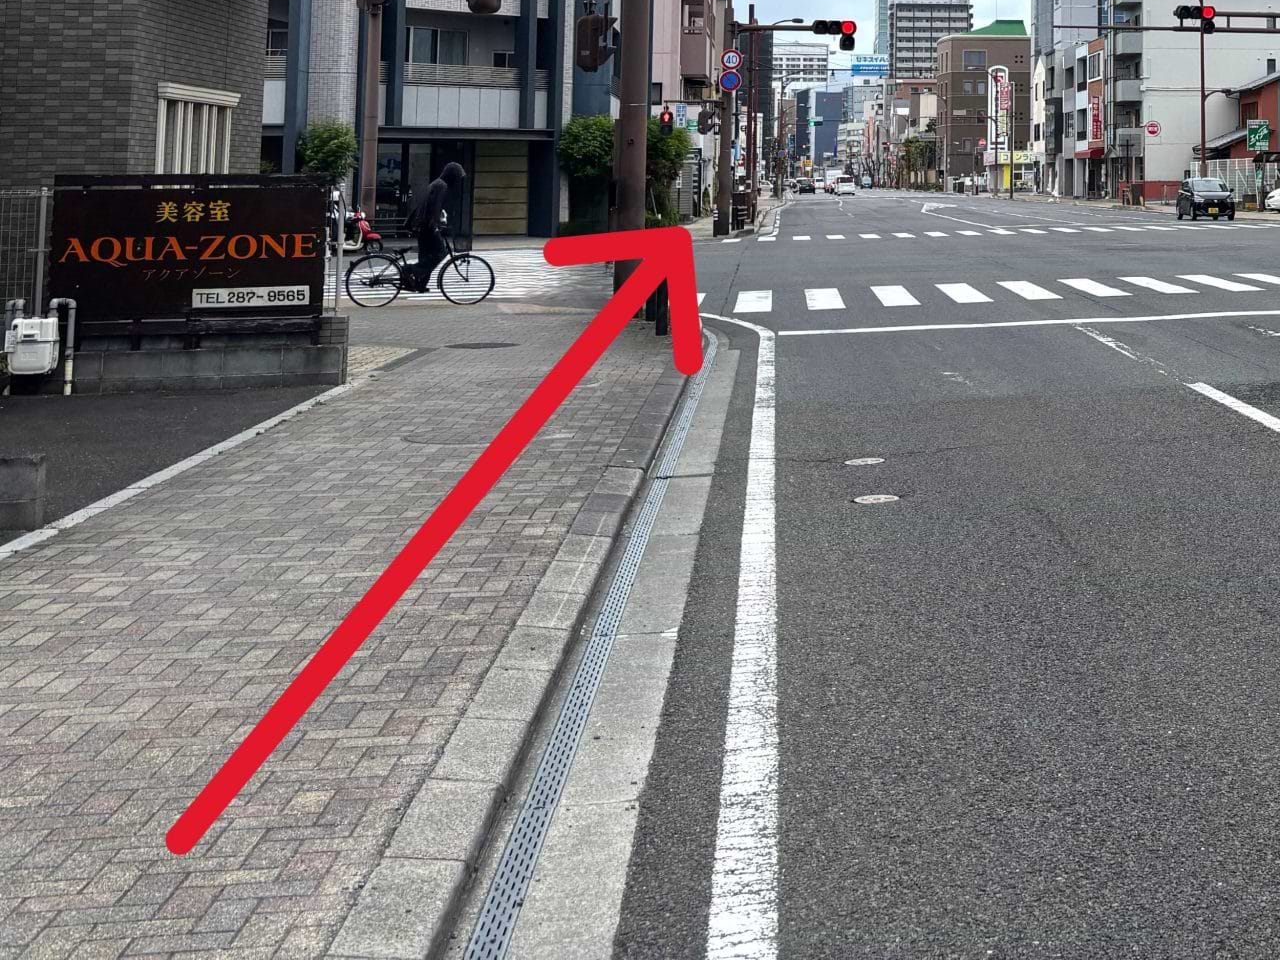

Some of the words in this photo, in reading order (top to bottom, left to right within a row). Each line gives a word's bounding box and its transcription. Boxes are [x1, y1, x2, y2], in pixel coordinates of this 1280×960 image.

[725, 55, 738, 64] 40
[156, 200, 232, 223] 美容室
[58, 233, 317, 267] AQUA-ZONE
[196, 292, 225, 304] TEL
[227, 289, 306, 304] 287-9565
